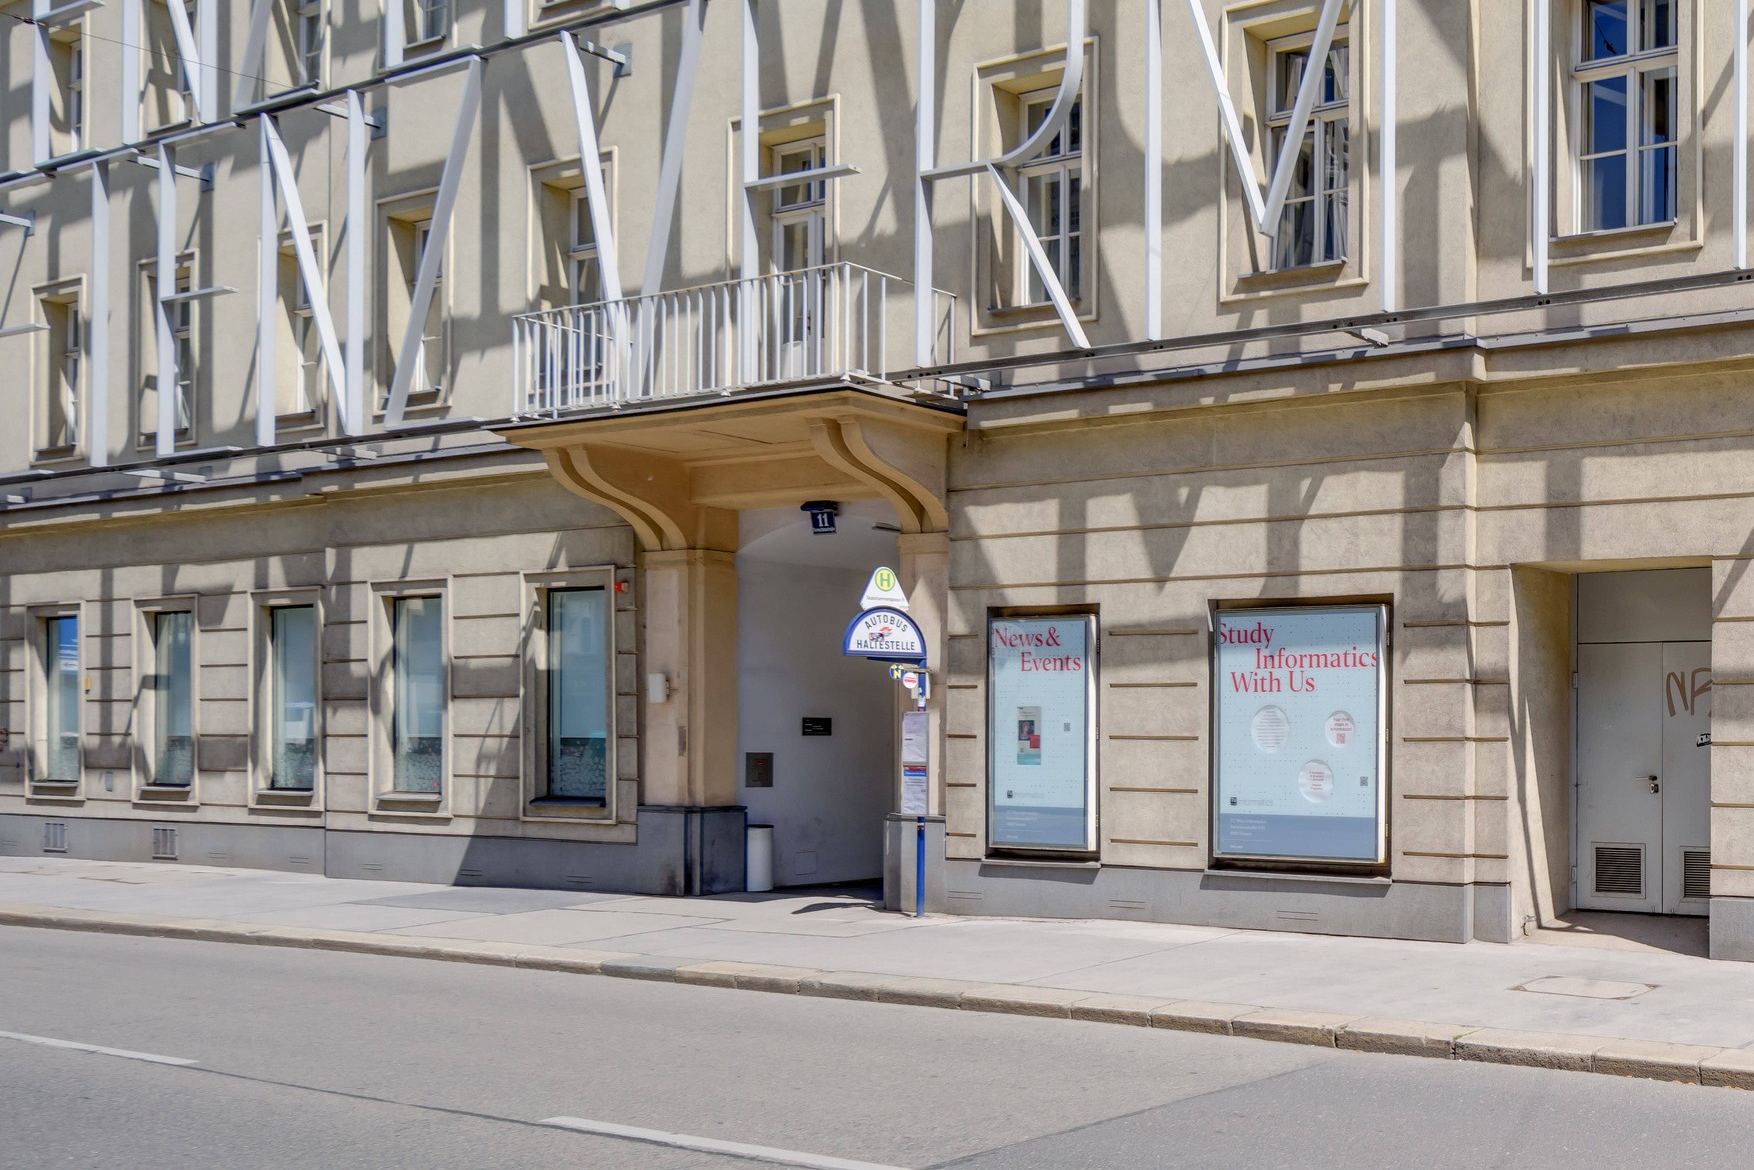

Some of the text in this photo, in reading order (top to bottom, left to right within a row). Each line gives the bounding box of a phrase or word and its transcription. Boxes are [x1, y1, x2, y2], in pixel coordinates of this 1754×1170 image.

[816, 513, 828, 527] 11
[880, 573, 891, 587] H
[865, 615, 908, 632] AUTOBUS
[1220, 622, 1274, 648] Study
[856, 639, 915, 651] HALTESTELLE
[1021, 651, 1081, 672] Events
[1256, 646, 1377, 669] Informatics
[1231, 670, 1316, 693] With Us
